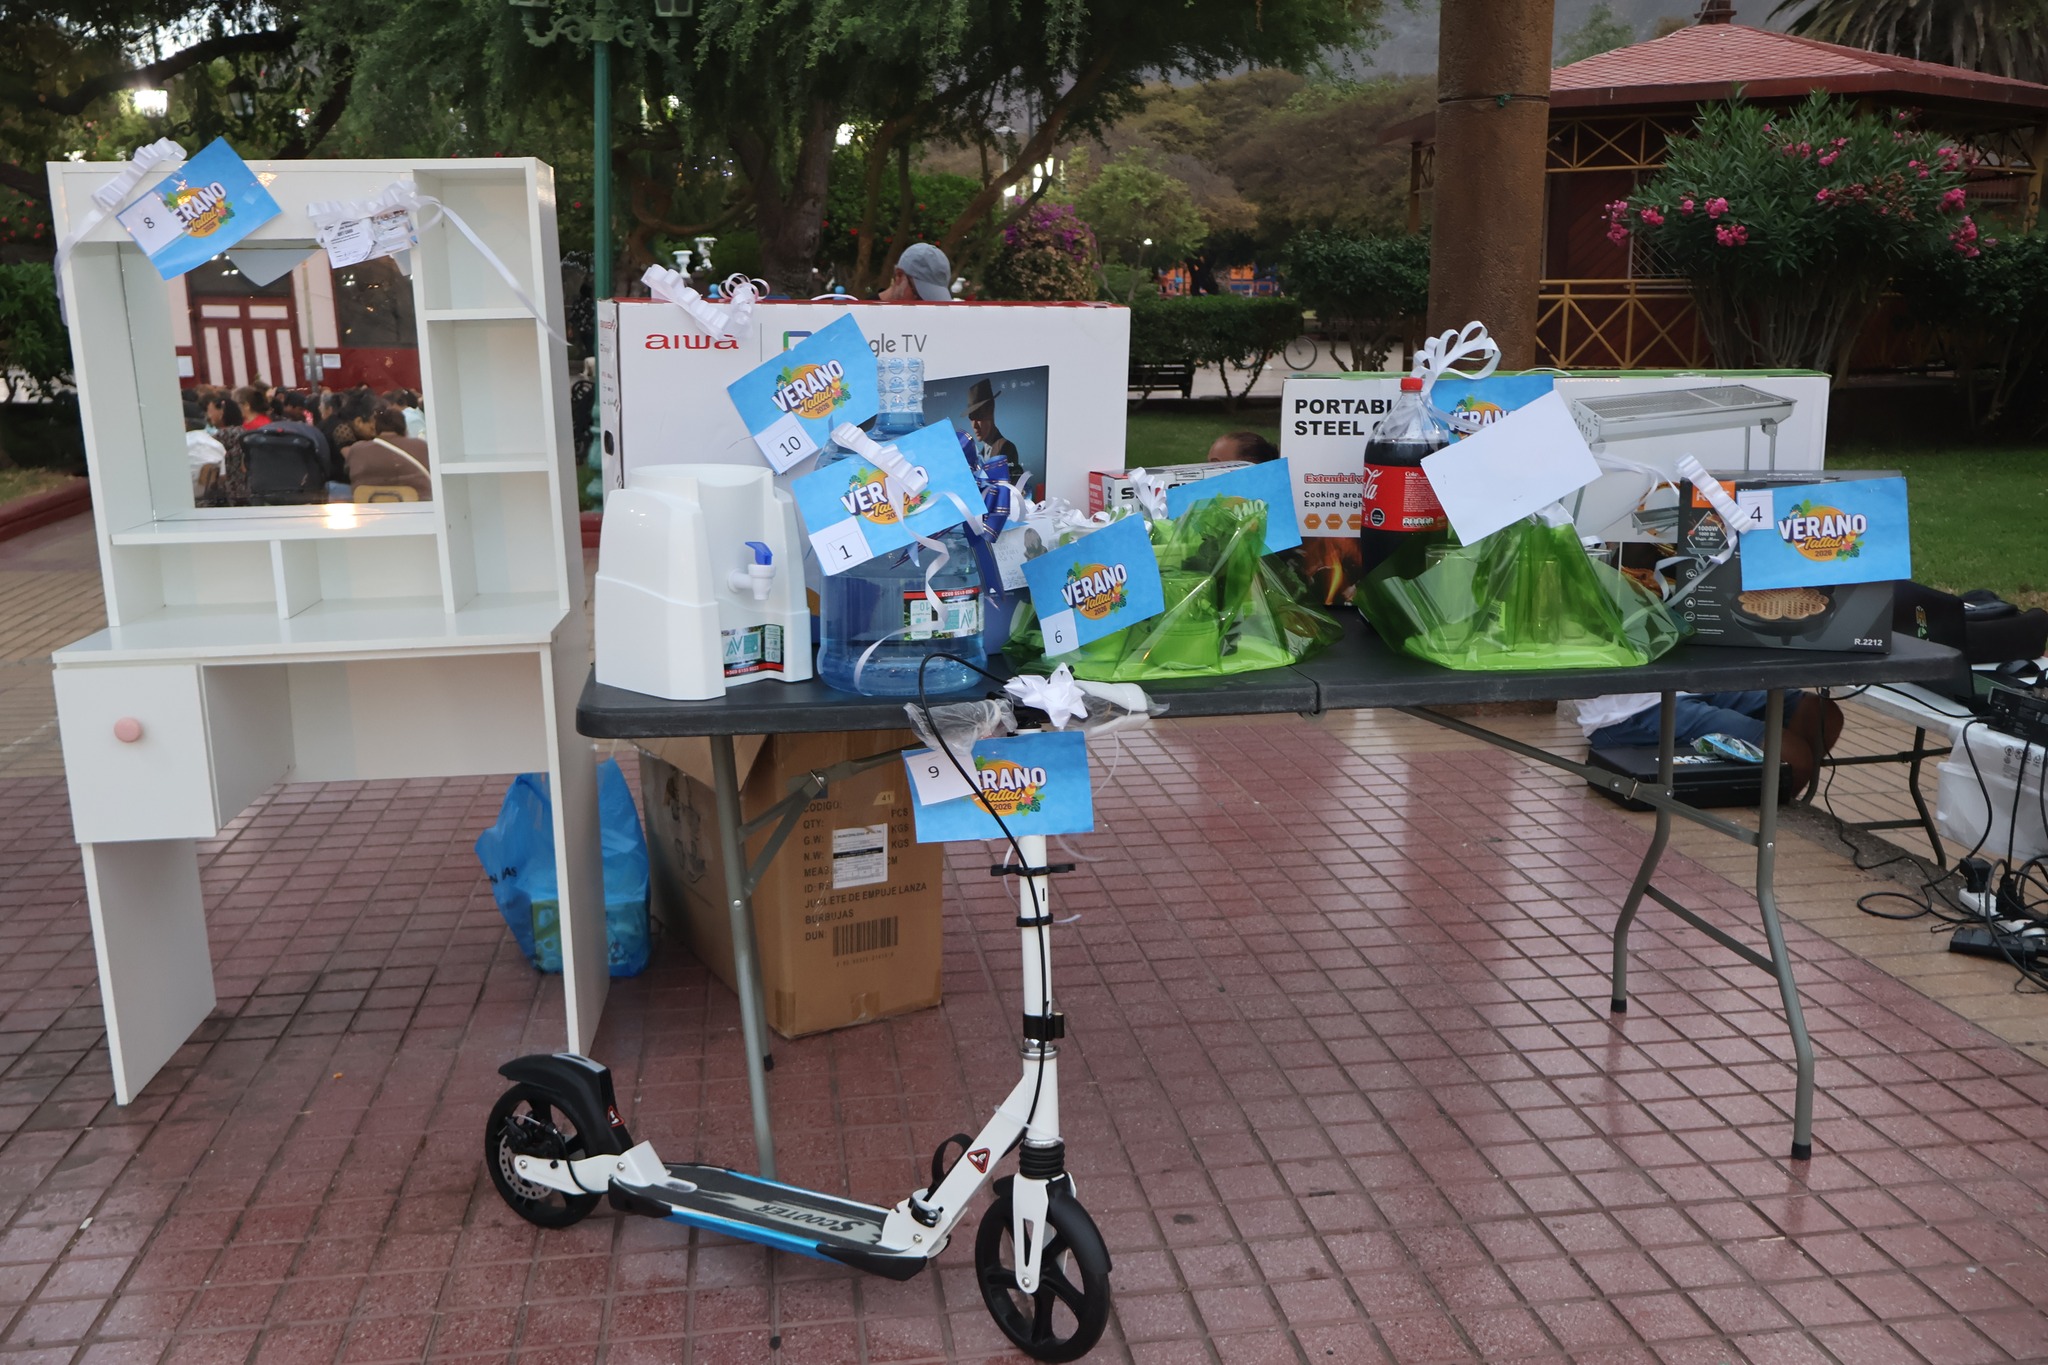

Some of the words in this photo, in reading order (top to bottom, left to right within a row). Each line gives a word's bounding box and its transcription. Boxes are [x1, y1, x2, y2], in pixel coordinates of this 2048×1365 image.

[173, 181, 227, 224] ERANO
[143, 216, 155, 229] 8
[645, 333, 739, 350] aiwa
[868, 333, 897, 357] gle
[901, 334, 928, 353] TV
[771, 359, 845, 412] VERANO
[800, 387, 832, 413] Taltal
[1294, 399, 1393, 414] PORTAB
[1294, 421, 1365, 436] STEEL
[778, 436, 801, 458] 10
[1304, 473, 1356, 484] Extended
[840, 465, 929, 515] VERO
[1304, 491, 1340, 500] Cooking
[1304, 500, 1337, 509] Expand
[1339, 500, 1363, 509] heigh
[1750, 505, 1763, 523] 4
[1777, 514, 1867, 543] VERANO
[1803, 535, 1842, 551] Taltal
[838, 544, 853, 561] 1
[1061, 563, 1128, 608] VERANO
[1083, 589, 1113, 611] Taltal
[1054, 630, 1063, 644] 6
[1854, 638, 1883, 646] R.2212
[928, 765, 940, 779] 9
[979, 767, 1047, 790] RANO
[983, 788, 1022, 802] Taltal
[890, 807, 909, 818] PCS
[993, 803, 1012, 811] 2026
[803, 819, 824, 830] QTY:
[891, 824, 909, 834] KGS
[803, 835, 824, 846] G.W:
[891, 839, 909, 849] KGS
[803, 851, 824, 862] N.W:
[804, 884, 815, 893] ID:
[848, 892, 861, 902] DE
[862, 886, 897, 900] EMPUJE
[899, 882, 927, 894] LANZA
[804, 909, 854, 925] BURBUJAS
